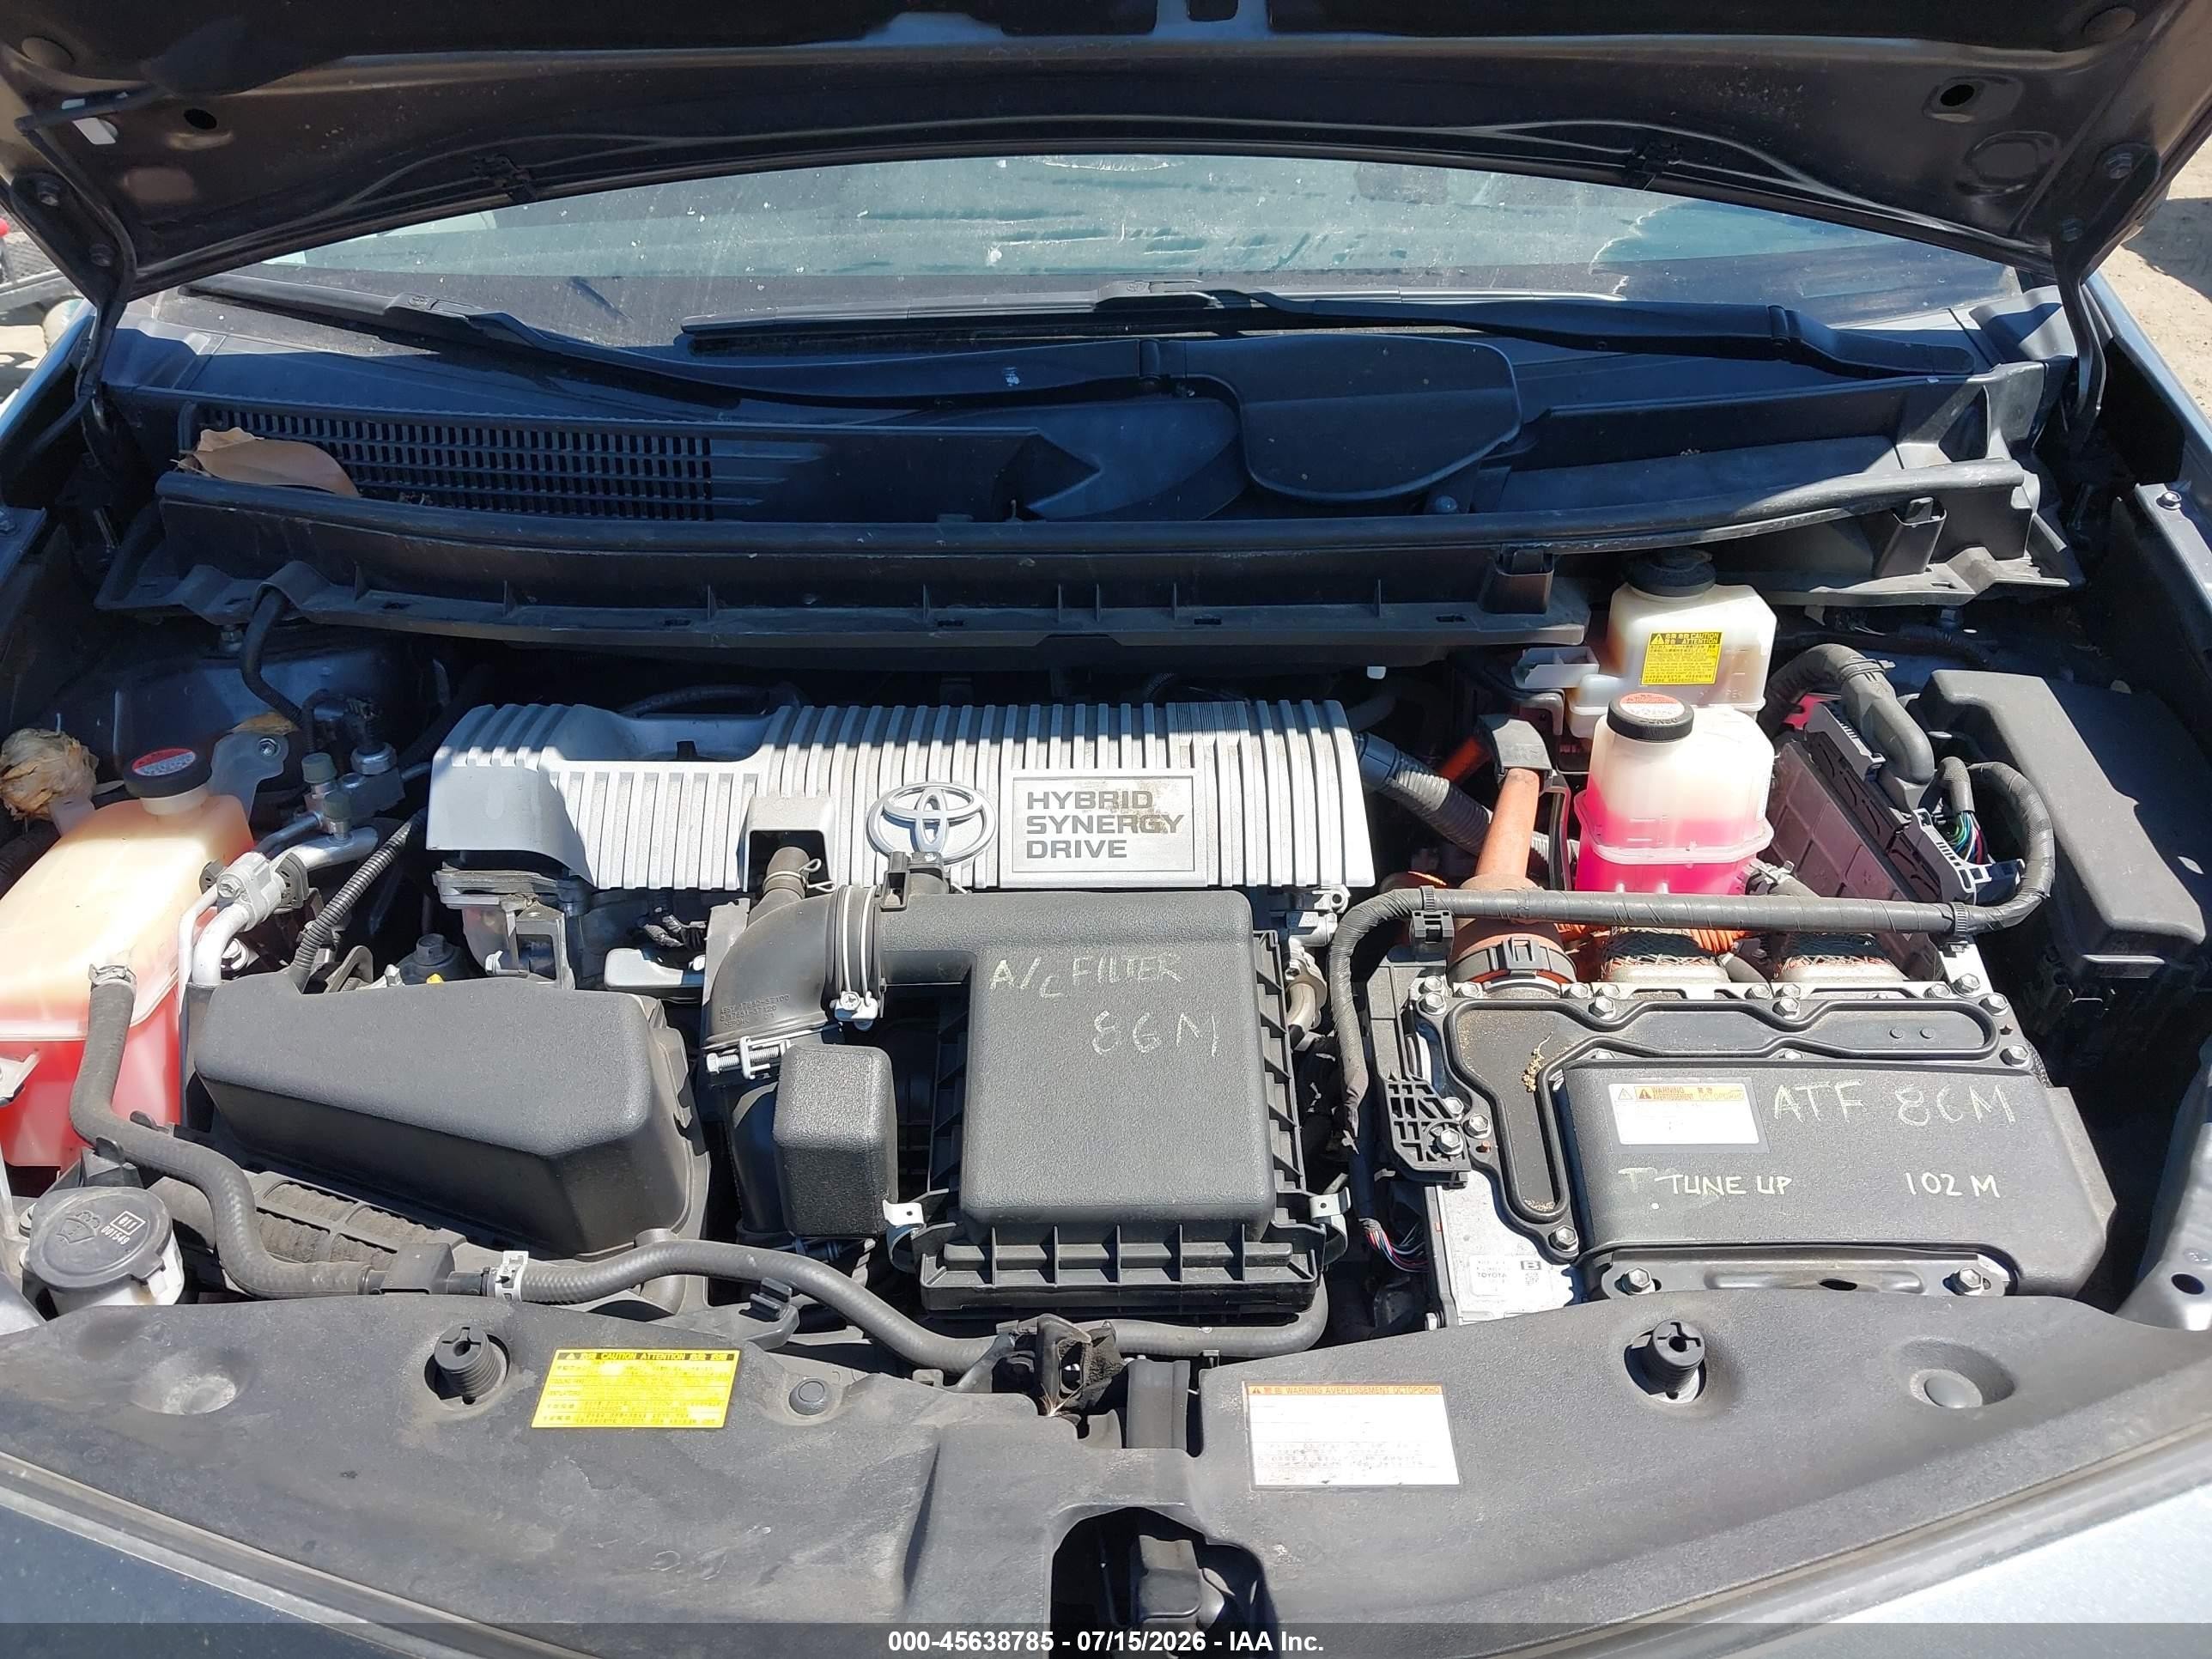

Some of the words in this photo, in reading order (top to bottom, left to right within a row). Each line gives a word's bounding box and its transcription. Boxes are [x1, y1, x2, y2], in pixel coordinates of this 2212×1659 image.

[1027, 791, 1153, 810] HYBRID
[1026, 814, 1185, 834] SYNERGY
[1026, 840, 1127, 859] DRIVE
[989, 956, 1062, 998] A/C
[1073, 951, 1183, 987] FILTER
[1774, 1079, 1867, 1123] ATF
[1655, 1174, 1747, 1196] TUNE
[1757, 1175, 1792, 1194] UP
